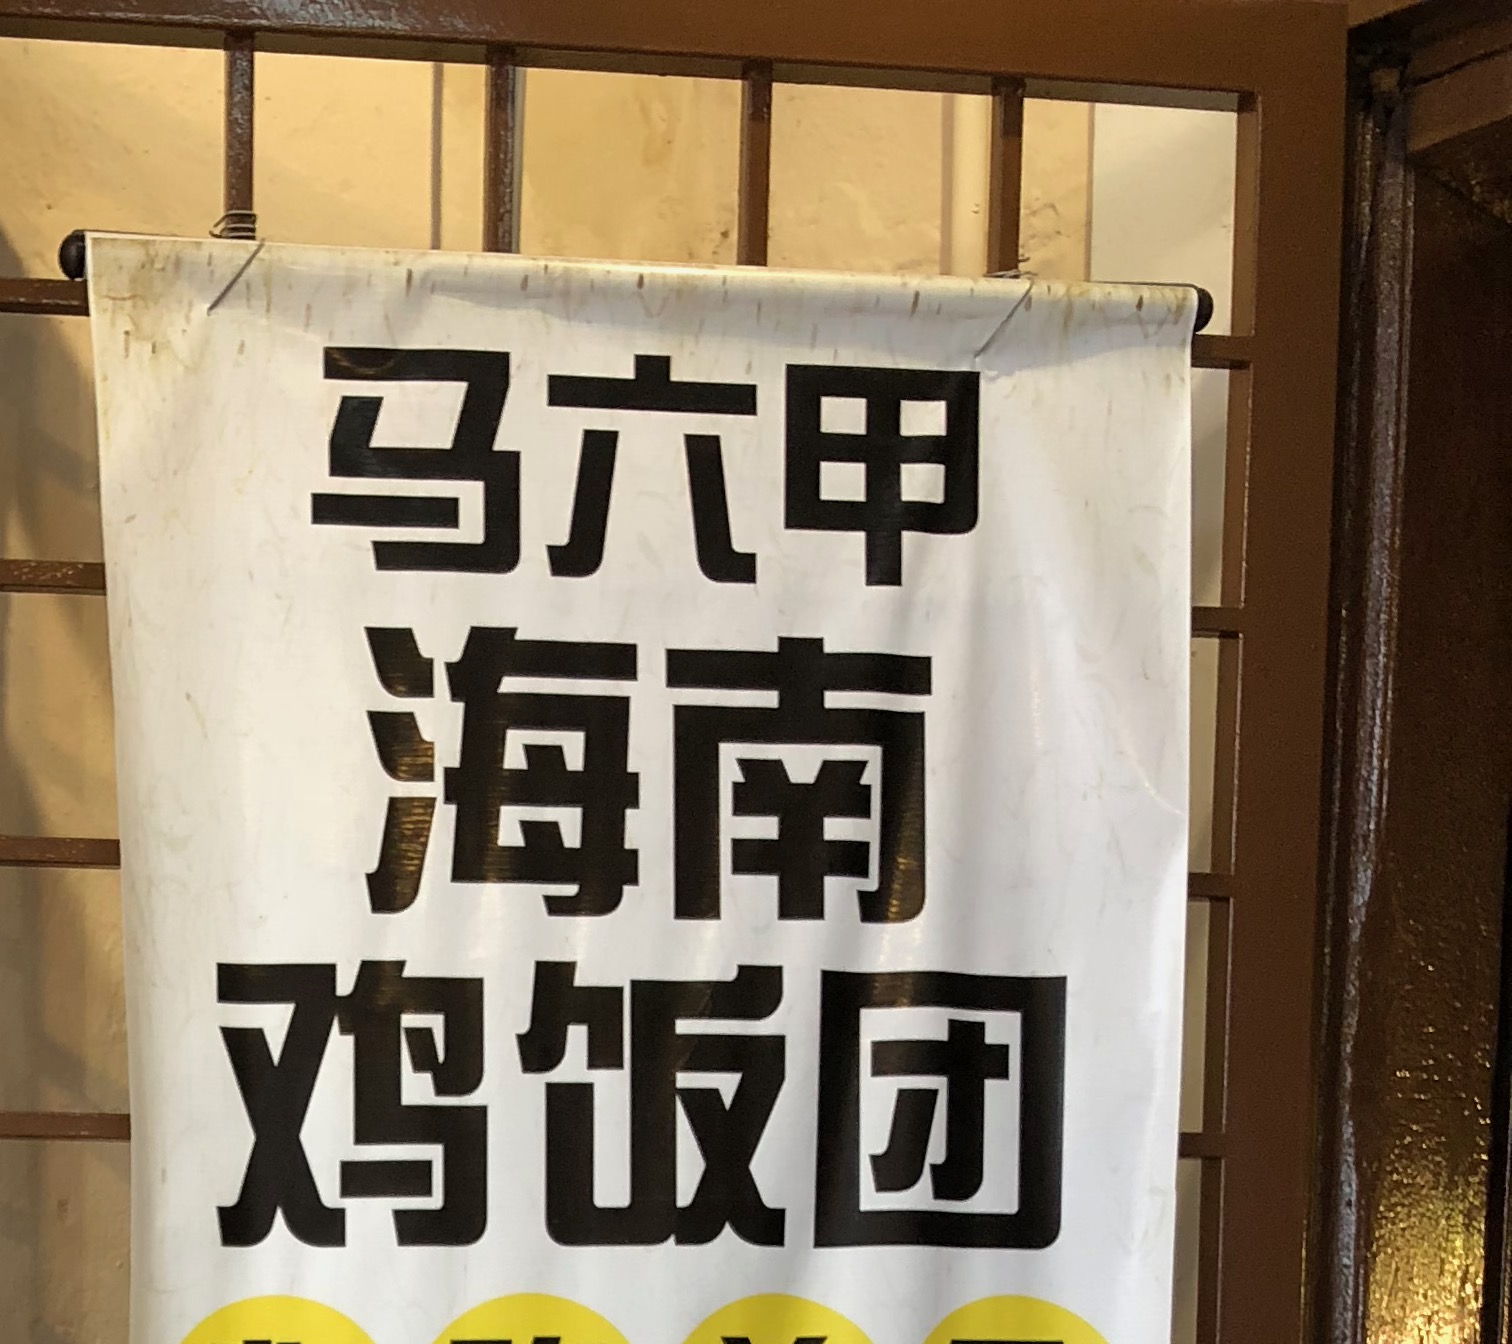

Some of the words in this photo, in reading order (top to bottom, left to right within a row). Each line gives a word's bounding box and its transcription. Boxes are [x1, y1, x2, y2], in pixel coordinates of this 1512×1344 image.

[311, 346, 981, 587] 马六甲
[364, 626, 932, 924] 海南
[216, 960, 1067, 1250] 鸡饭团
